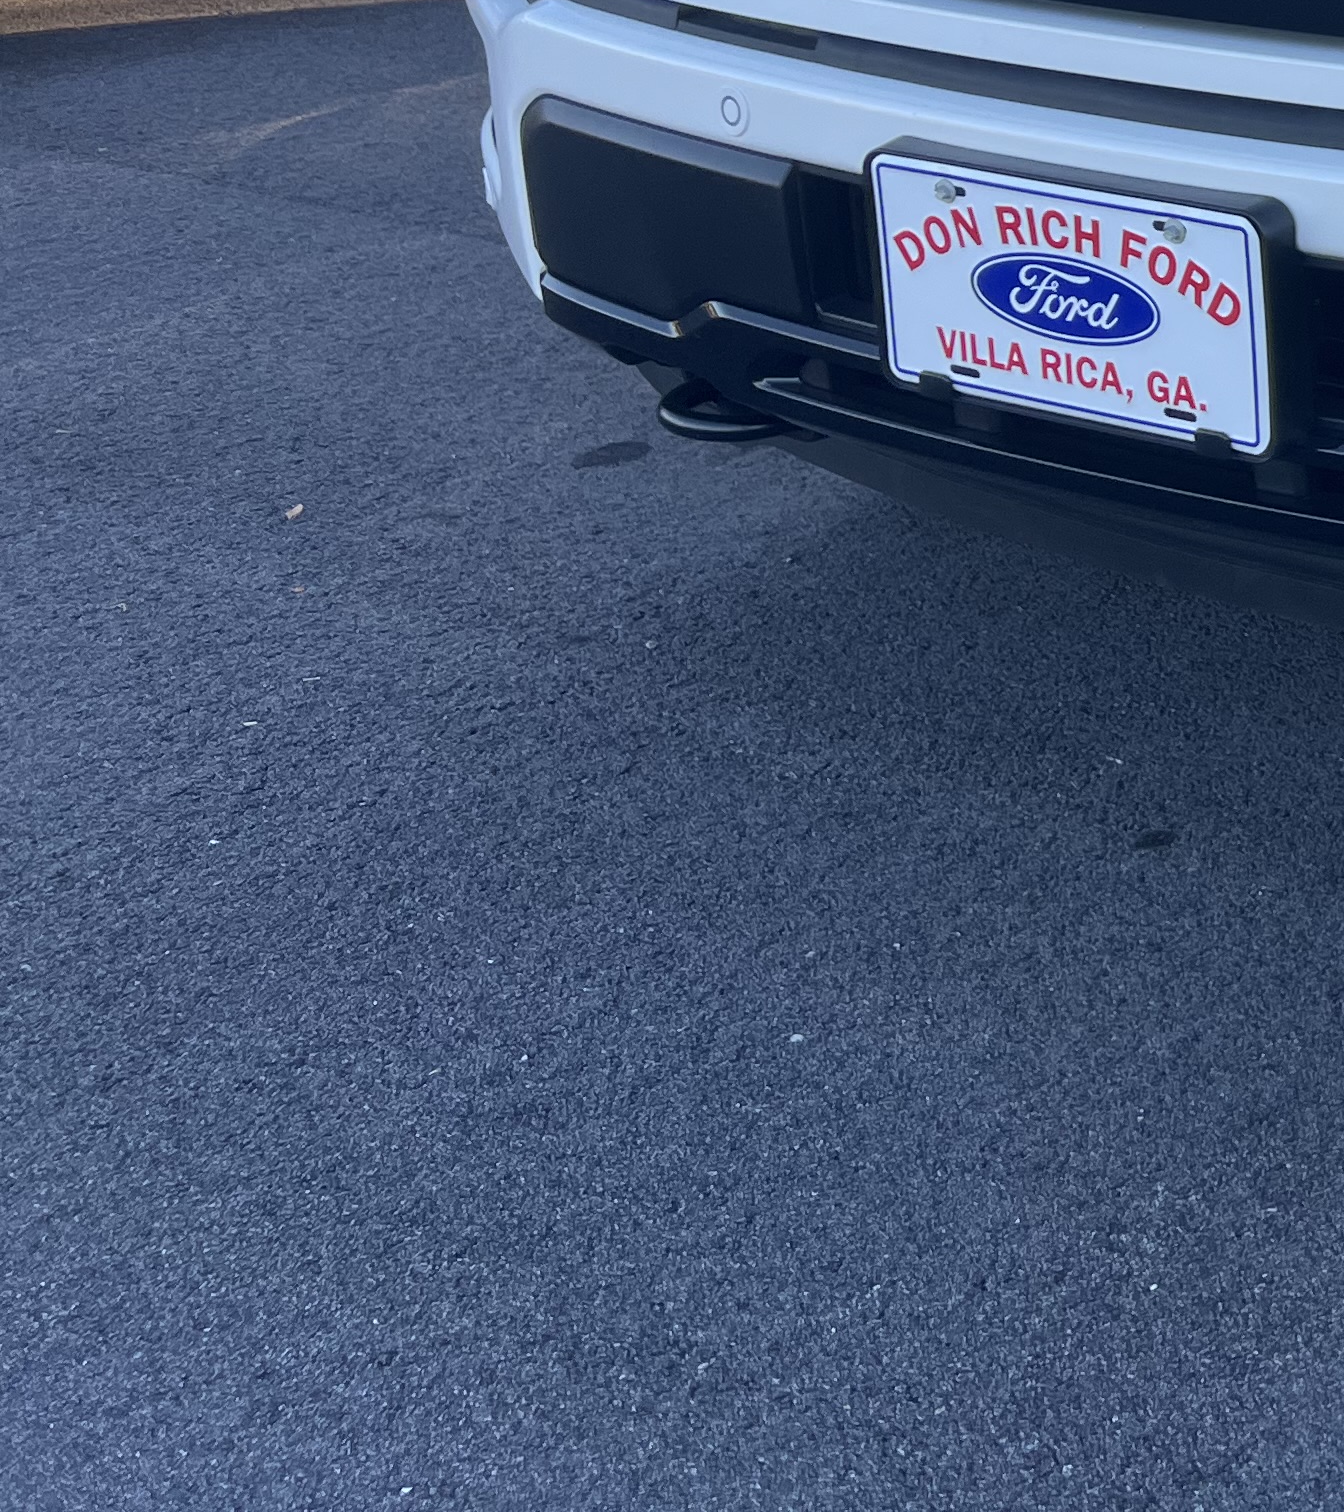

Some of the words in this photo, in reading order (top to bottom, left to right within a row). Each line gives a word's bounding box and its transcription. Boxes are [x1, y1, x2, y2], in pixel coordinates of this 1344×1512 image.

[893, 206, 983, 272] DON
[994, 205, 1102, 259] RICH
[1120, 230, 1242, 328] FORD
[1008, 264, 1120, 330] Ford
[936, 326, 1030, 376] VILLA
[1040, 348, 1135, 405] RICA,
[1146, 370, 1208, 413] GA.
